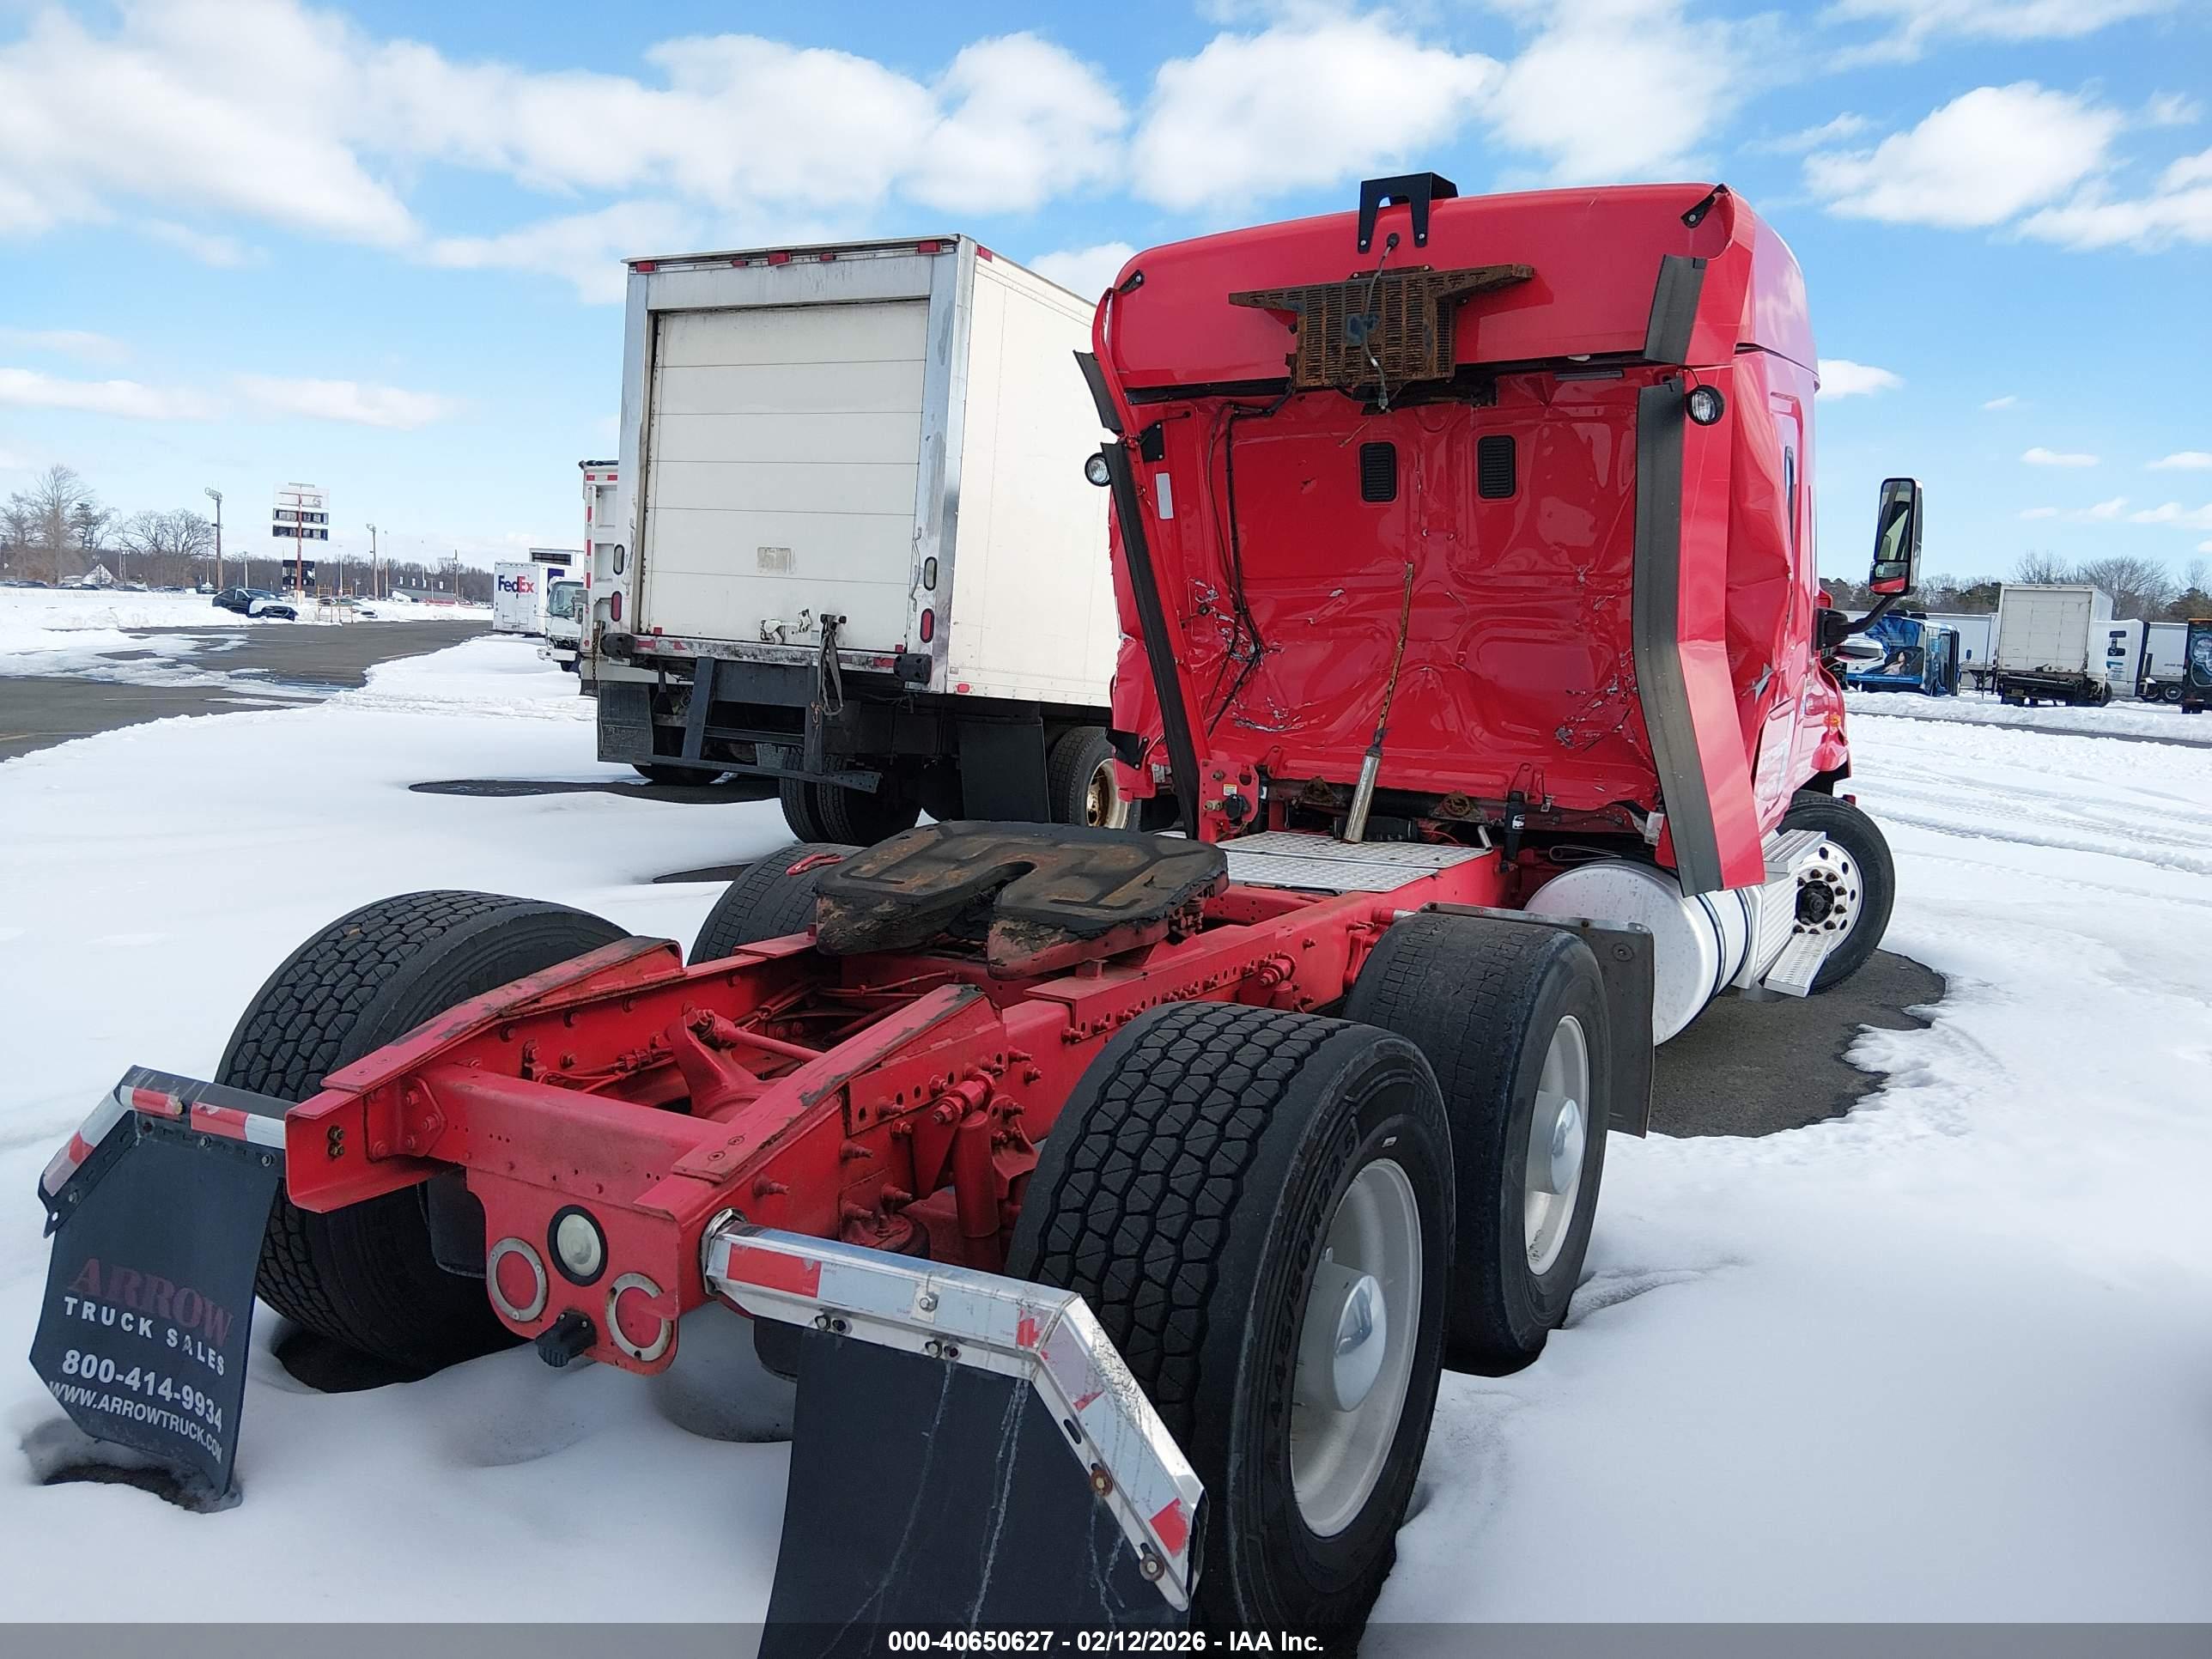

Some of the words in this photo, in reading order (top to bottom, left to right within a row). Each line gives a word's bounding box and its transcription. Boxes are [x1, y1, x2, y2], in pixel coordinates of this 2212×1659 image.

[498, 575, 534, 592] FedEx
[64, 1297, 153, 1339] TRUCK
[167, 1328, 224, 1376] SALES
[66, 1258, 234, 1346] ARROW
[62, 1350, 222, 1432] 800-414-9934
